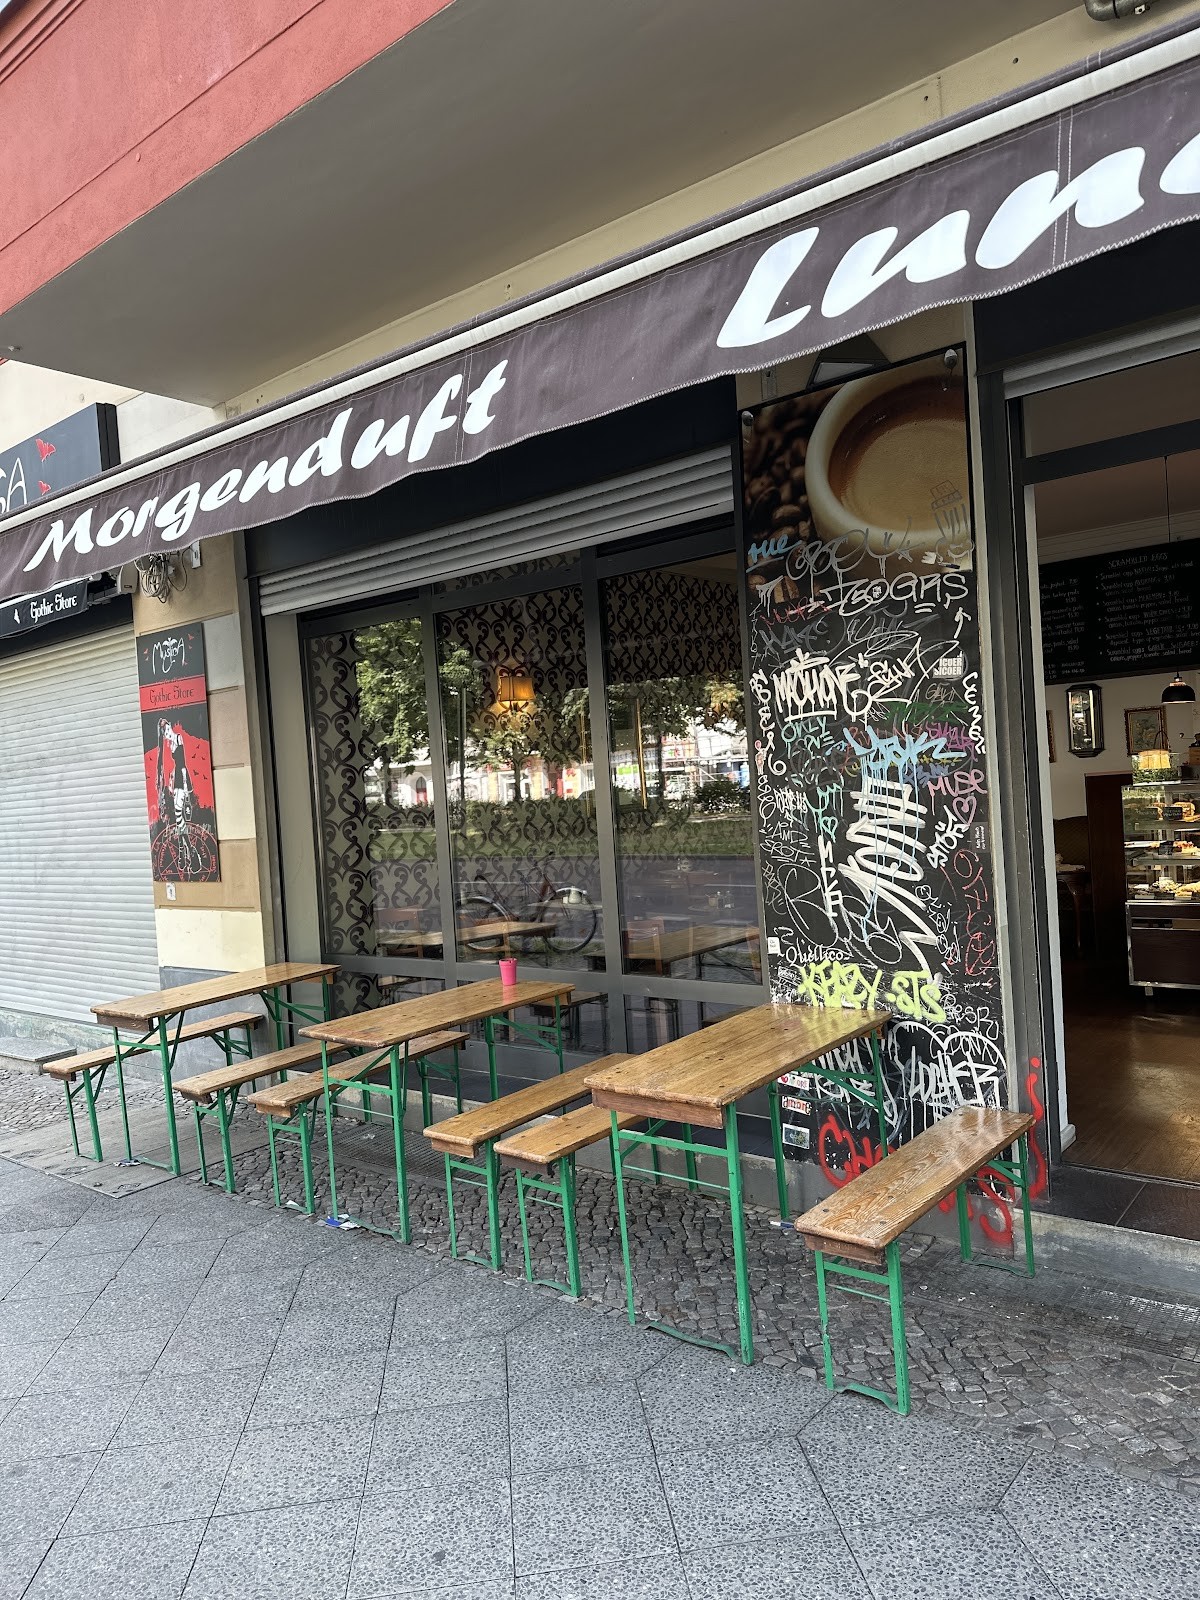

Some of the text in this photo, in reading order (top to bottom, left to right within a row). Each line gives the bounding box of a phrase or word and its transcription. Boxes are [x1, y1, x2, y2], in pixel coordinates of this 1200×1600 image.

[23, 359, 508, 572] Morgenduft
[30, 592, 77, 623] Gothic Store
[150, 685, 195, 706] Gothic Store
